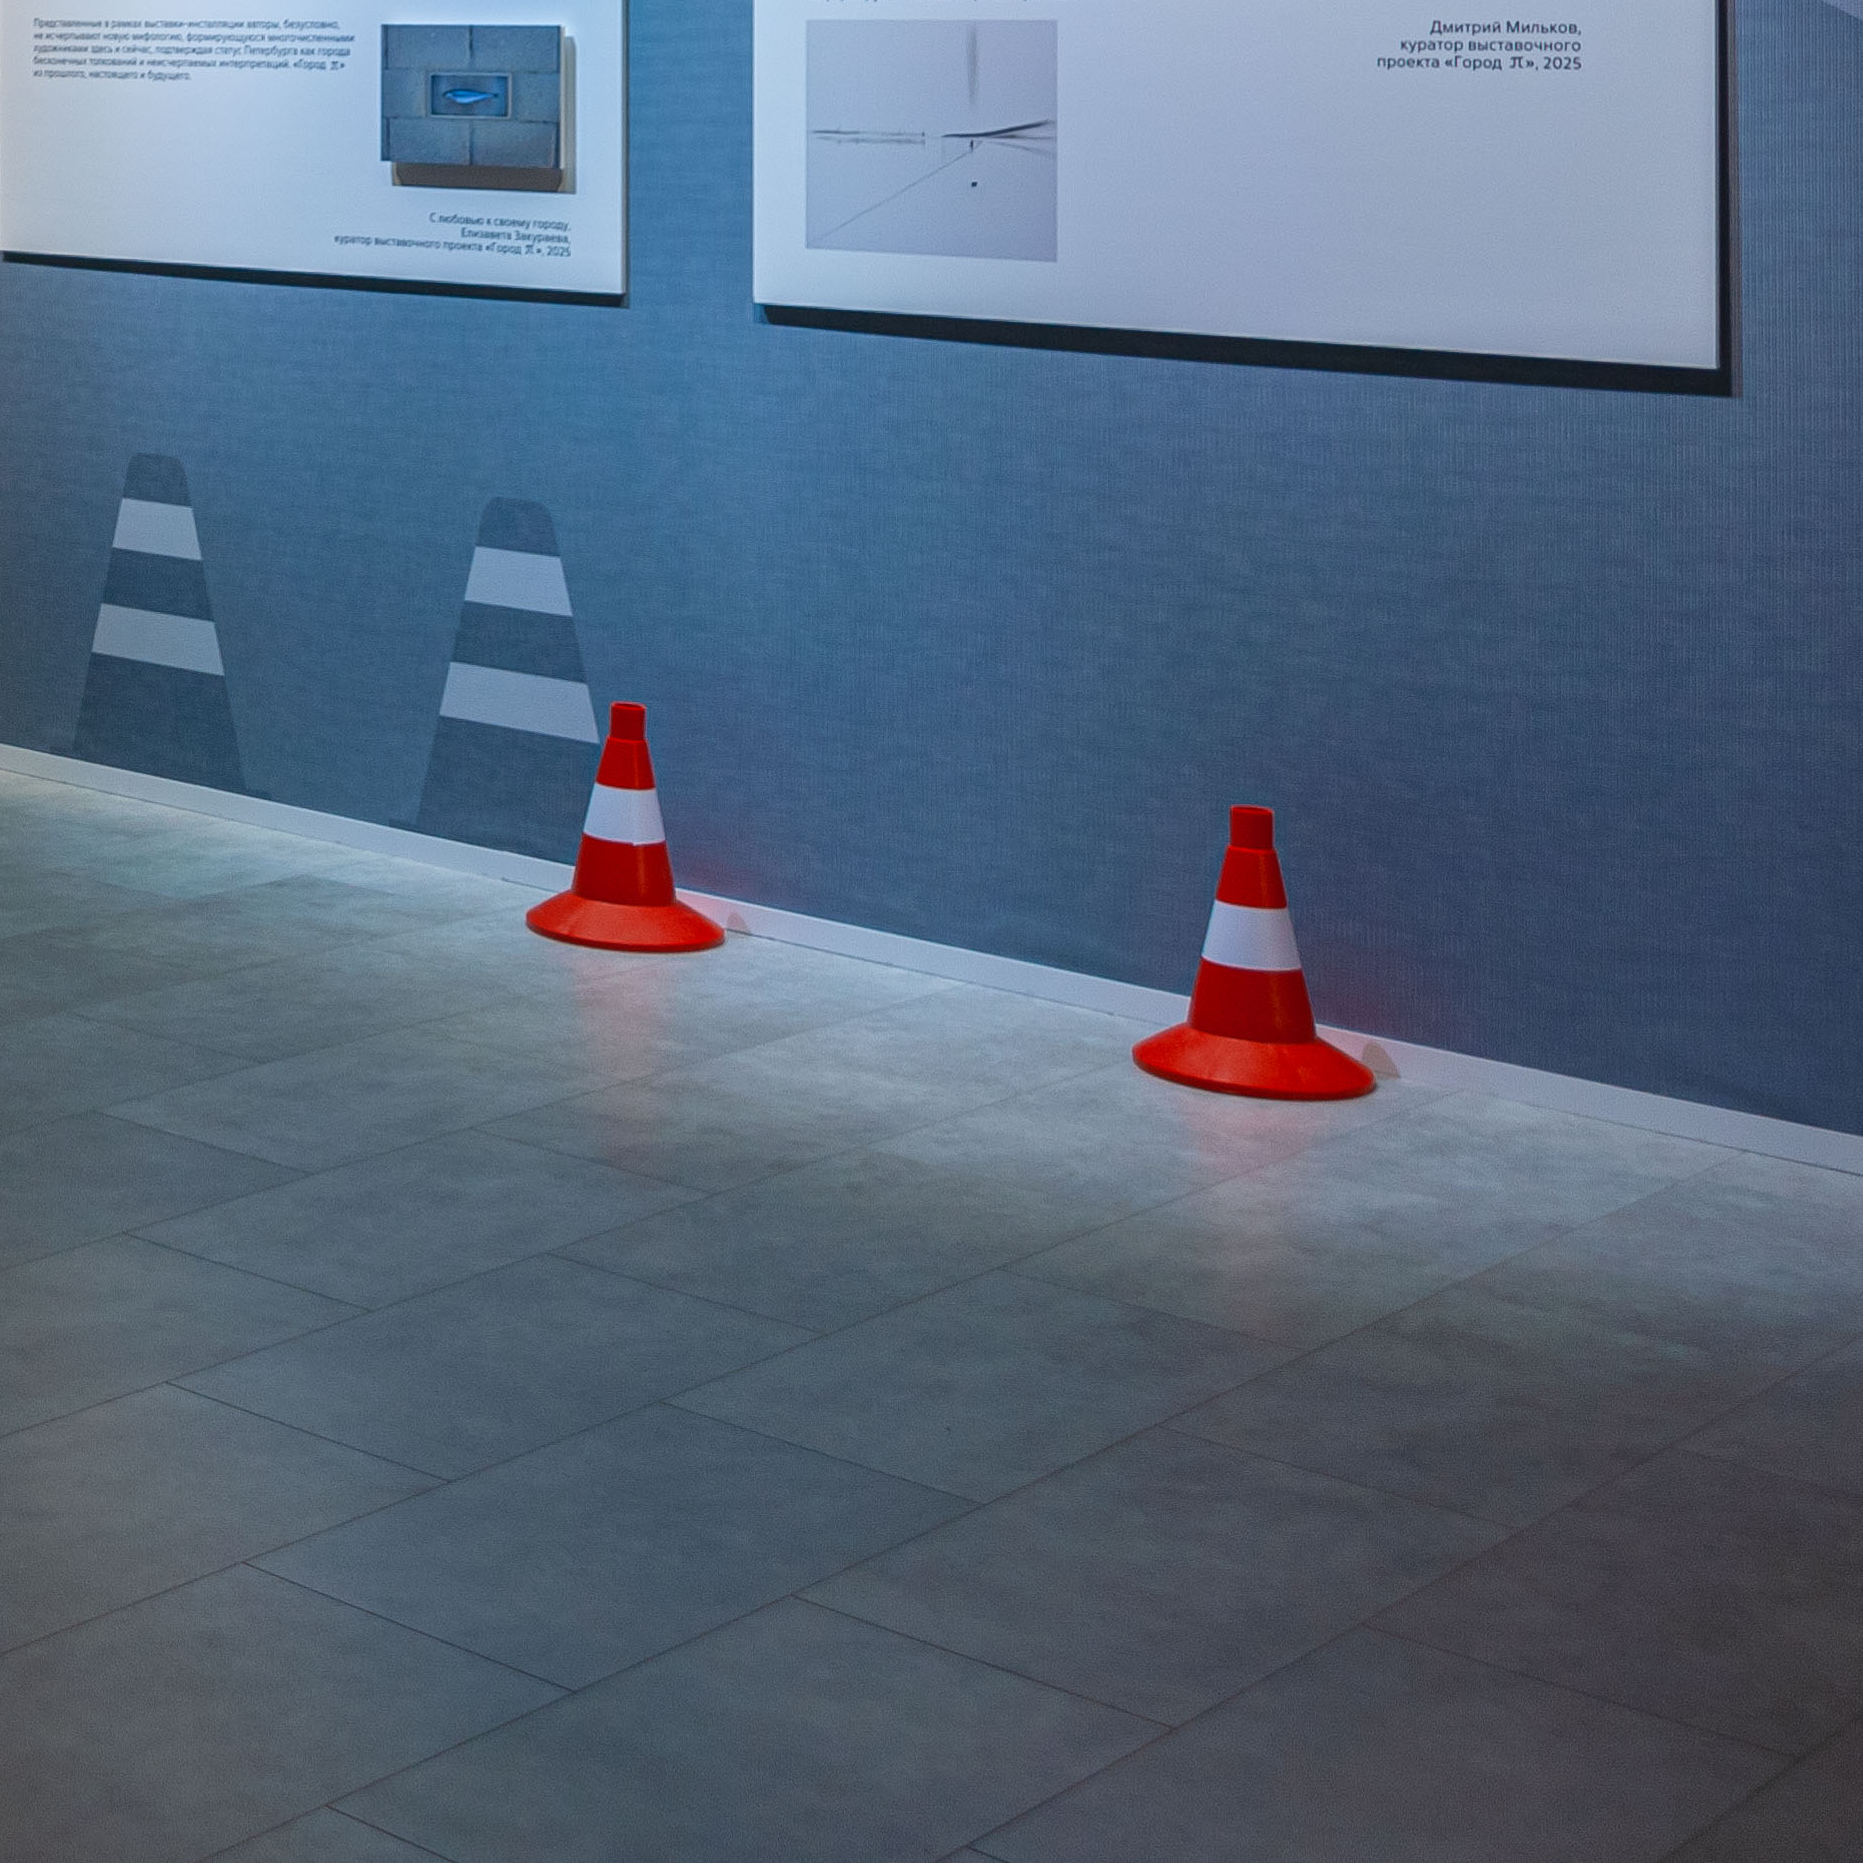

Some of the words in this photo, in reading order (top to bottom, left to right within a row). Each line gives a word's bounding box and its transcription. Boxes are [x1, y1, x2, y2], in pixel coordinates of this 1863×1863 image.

[1429, 19, 1501, 37] Дмитрий
[1505, 19, 1582, 38] Мильков,
[1399, 39, 1464, 55] куратор
[1467, 39, 1582, 53] выставочного
[1376, 56, 1440, 72] проекта
[1444, 54, 1502, 73] «Город
[1542, 55, 1582, 71] 2025
